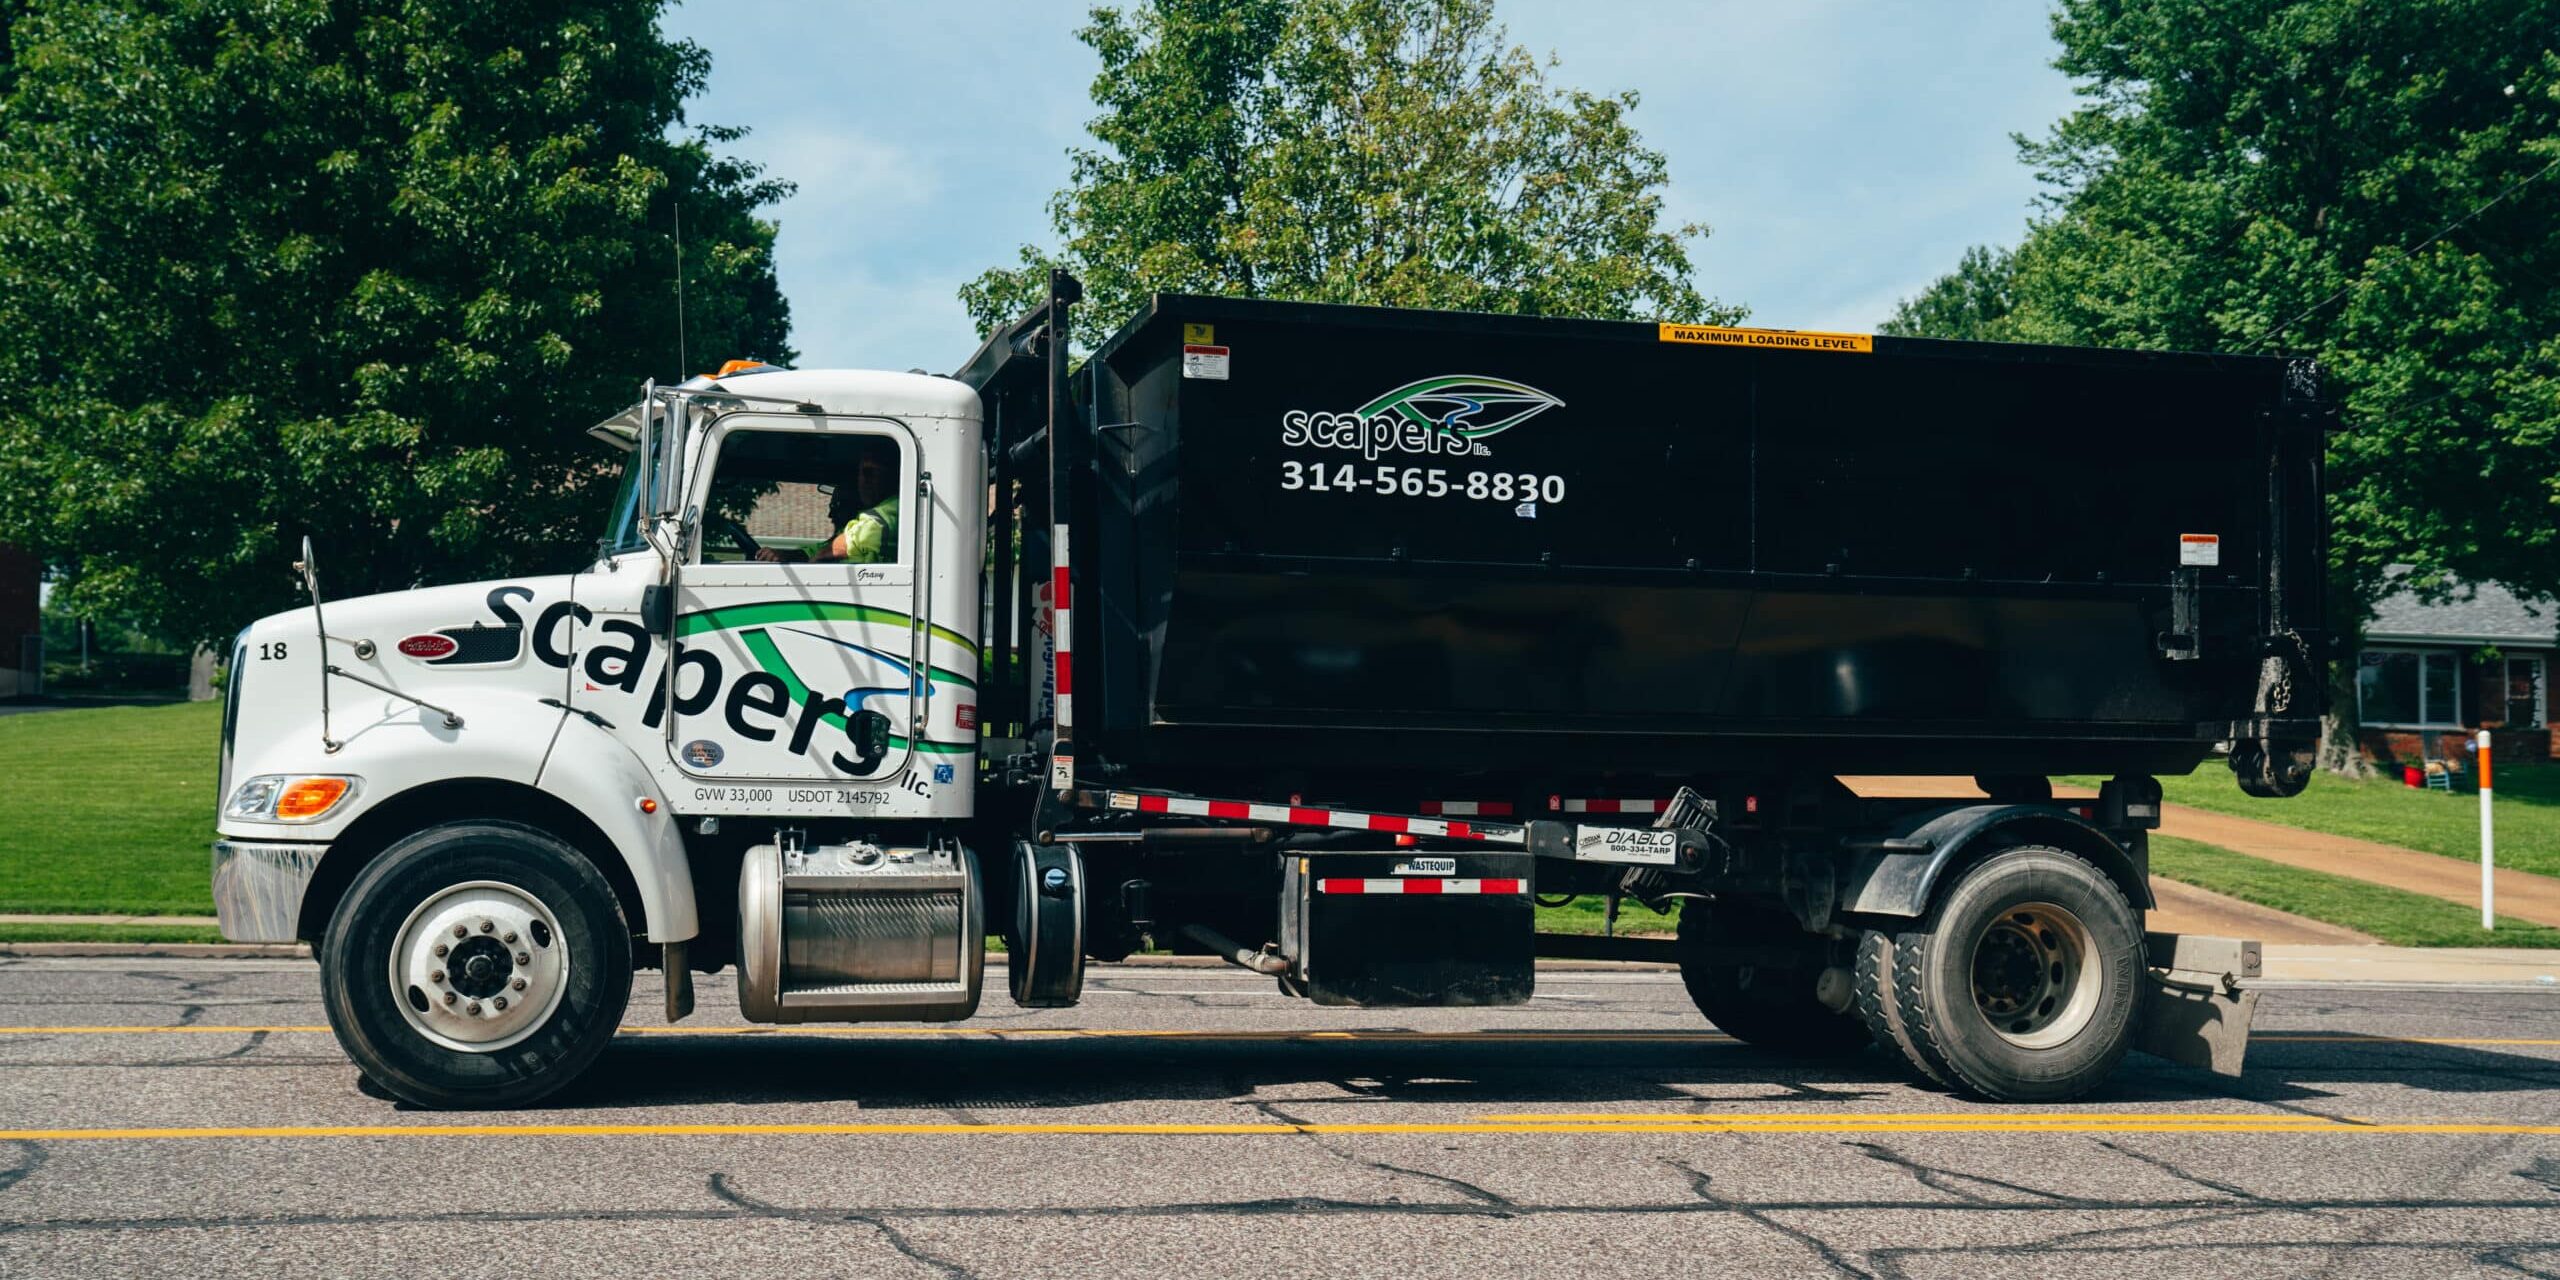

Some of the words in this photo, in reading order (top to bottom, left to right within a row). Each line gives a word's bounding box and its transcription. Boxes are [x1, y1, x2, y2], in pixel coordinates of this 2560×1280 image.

[1674, 329, 1744, 343] MAXIMUM
[1748, 334, 1810, 347] LOADING
[1814, 338, 1858, 349] LEVEL
[1283, 410, 1472, 461] scapers
[1473, 443, 1492, 456] llc.
[1281, 461, 1565, 503] 314-565-8830
[259, 642, 287, 660] 18
[899, 768, 933, 799] llc.
[694, 788, 726, 801] GVW
[729, 788, 773, 803] 33,000
[788, 789, 833, 803] USDOT
[836, 790, 890, 805] 2145792
[1605, 831, 1675, 846] DIABLO
[1610, 845, 1671, 855] 800-334-TARP
[1408, 860, 1455, 871] WASTEQUIP
